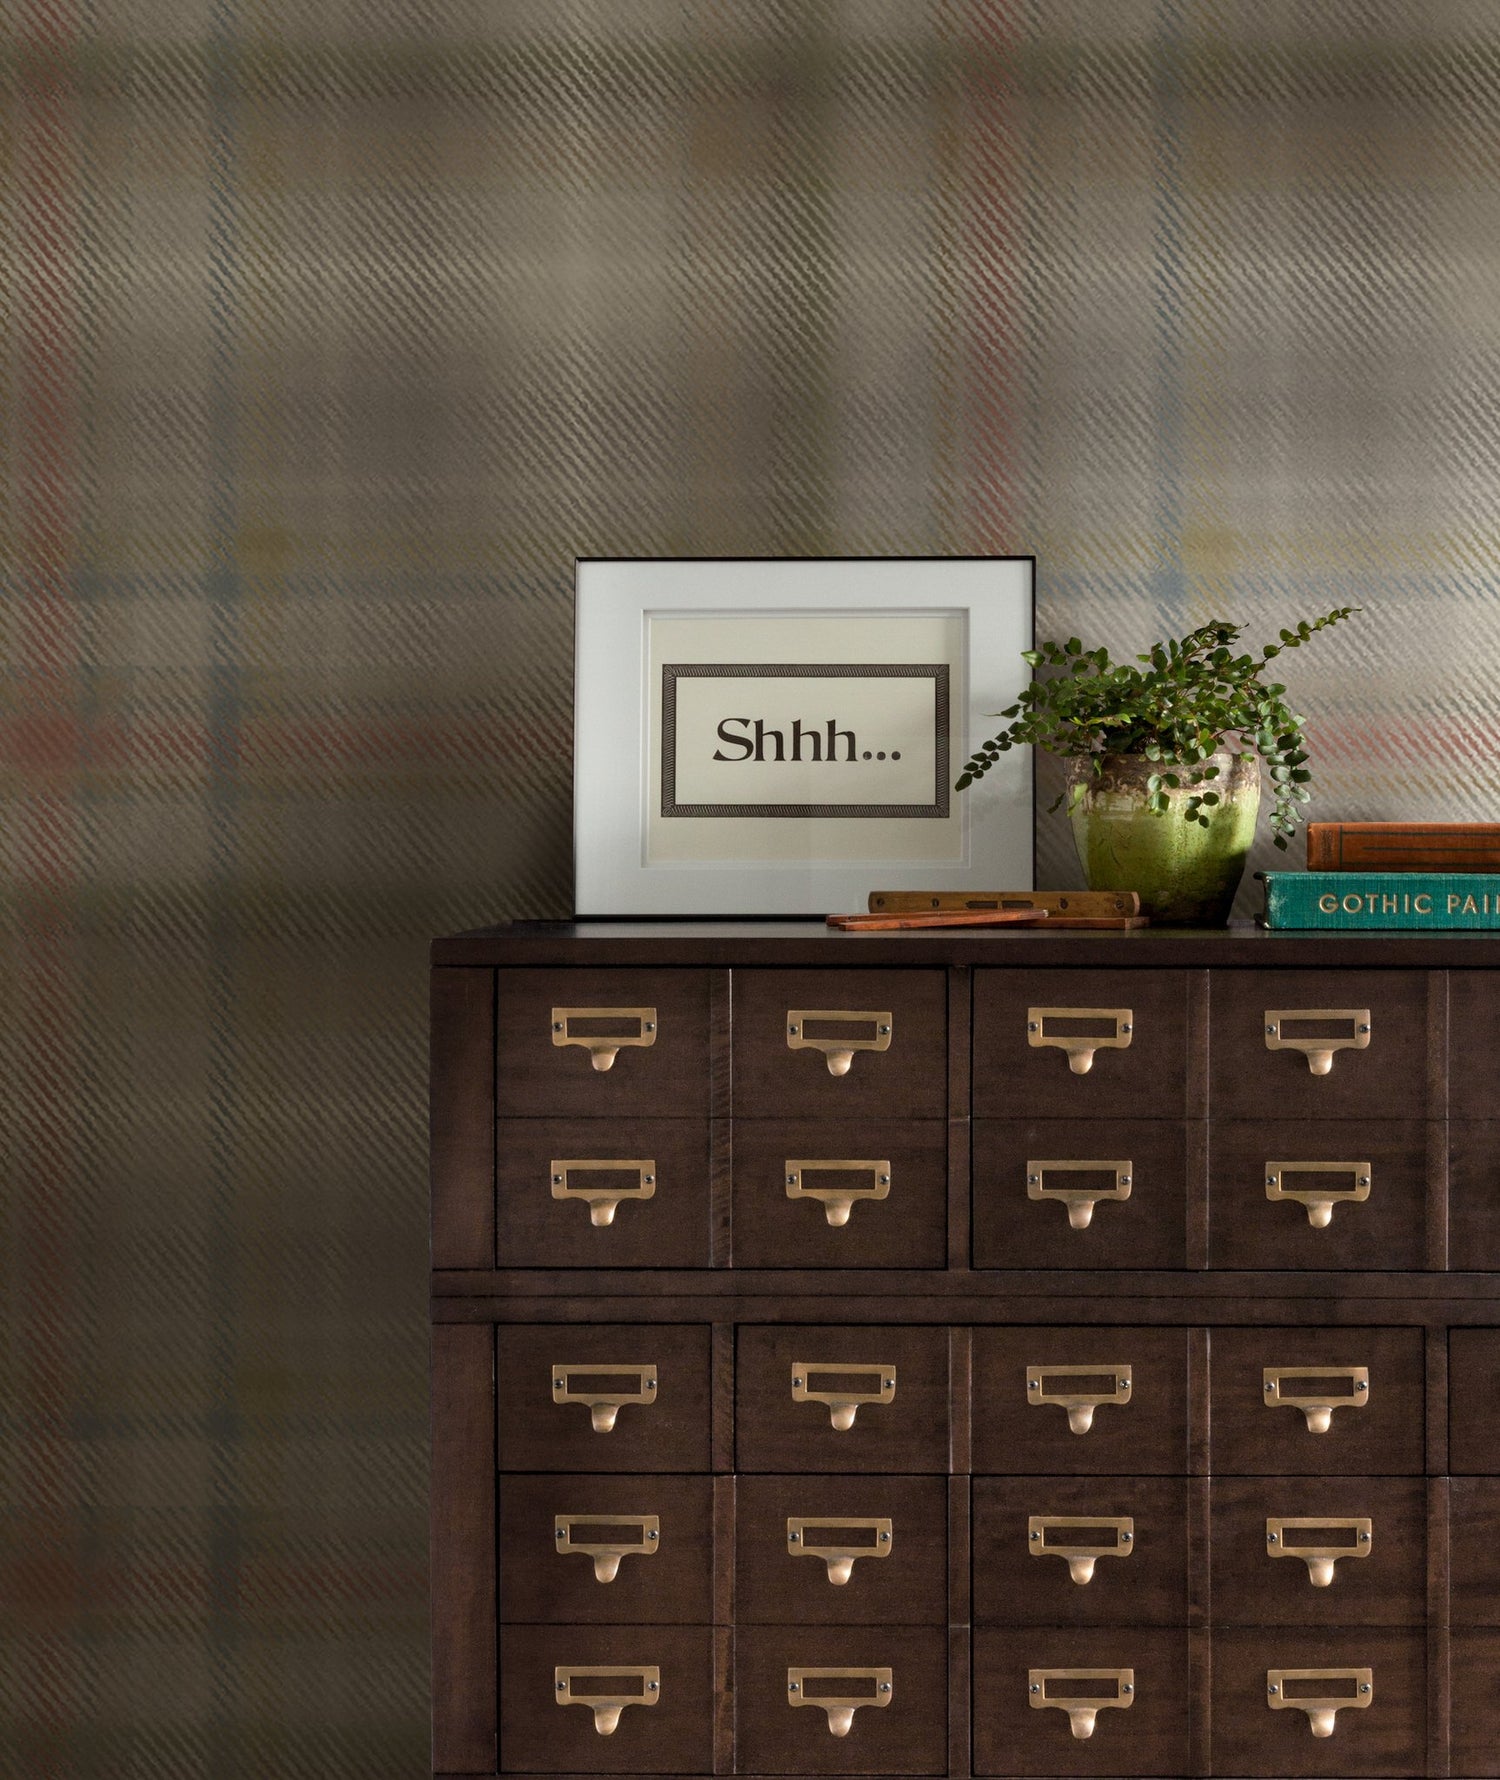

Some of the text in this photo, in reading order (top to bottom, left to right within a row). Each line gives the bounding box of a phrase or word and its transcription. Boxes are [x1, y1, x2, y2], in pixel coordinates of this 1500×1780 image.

[712, 717, 901, 762] Shhh...
[1318, 893, 1500, 914] GOTHIC PAI
